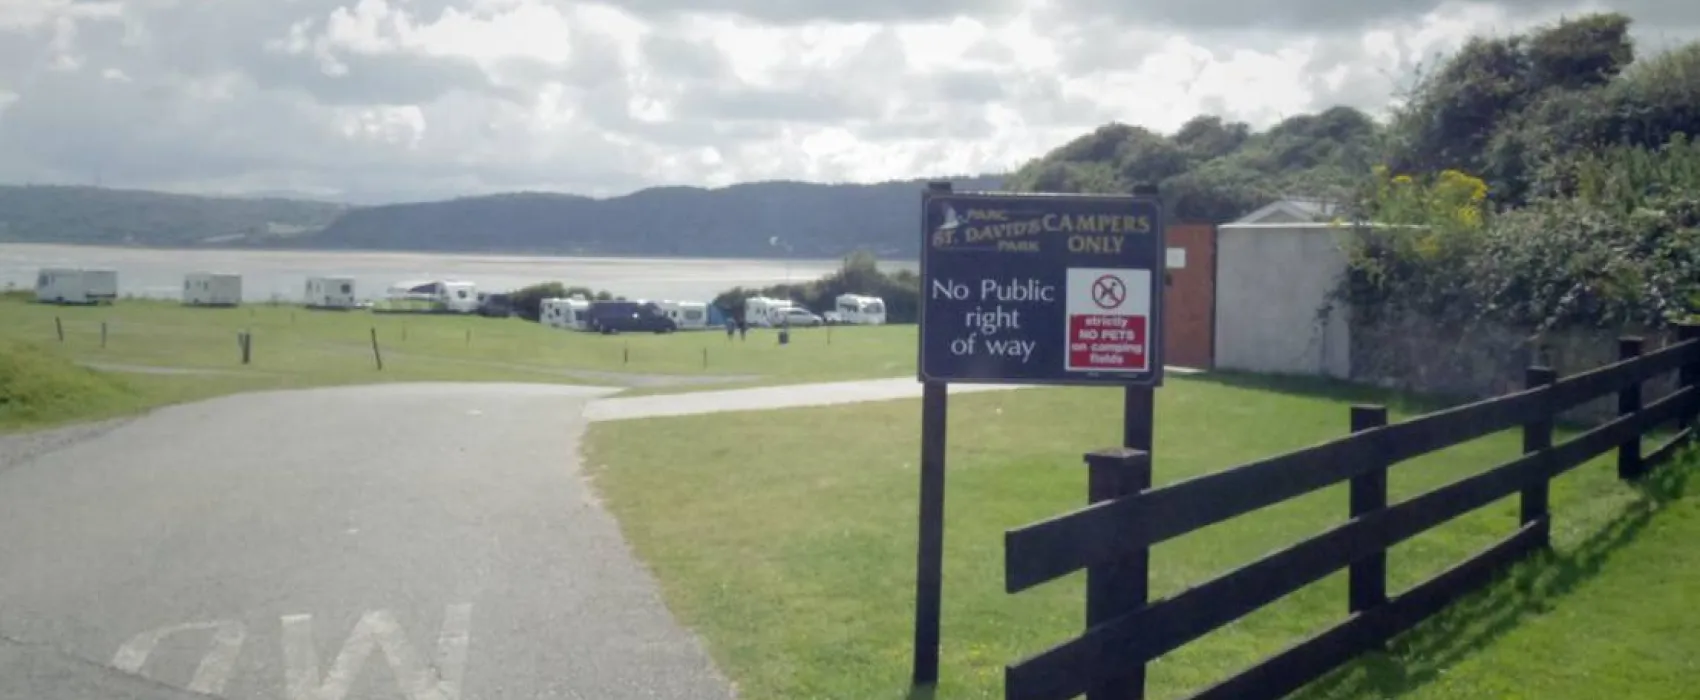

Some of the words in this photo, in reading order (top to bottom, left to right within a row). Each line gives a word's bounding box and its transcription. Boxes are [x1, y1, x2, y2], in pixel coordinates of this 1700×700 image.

[967, 209, 1008, 220] PARC
[1042, 213, 1150, 233] CAMPERS
[997, 240, 1040, 252] PARK
[1067, 235, 1124, 253] ONLY
[932, 279, 969, 300] No
[981, 278, 1055, 301] Public
[964, 303, 1020, 335] right
[1079, 329, 1098, 340] NO
[1101, 329, 1135, 341] PETS
[950, 332, 976, 355] of
[985, 340, 1036, 363] way
[1071, 343, 1087, 352] on
[1091, 342, 1142, 354] camping
